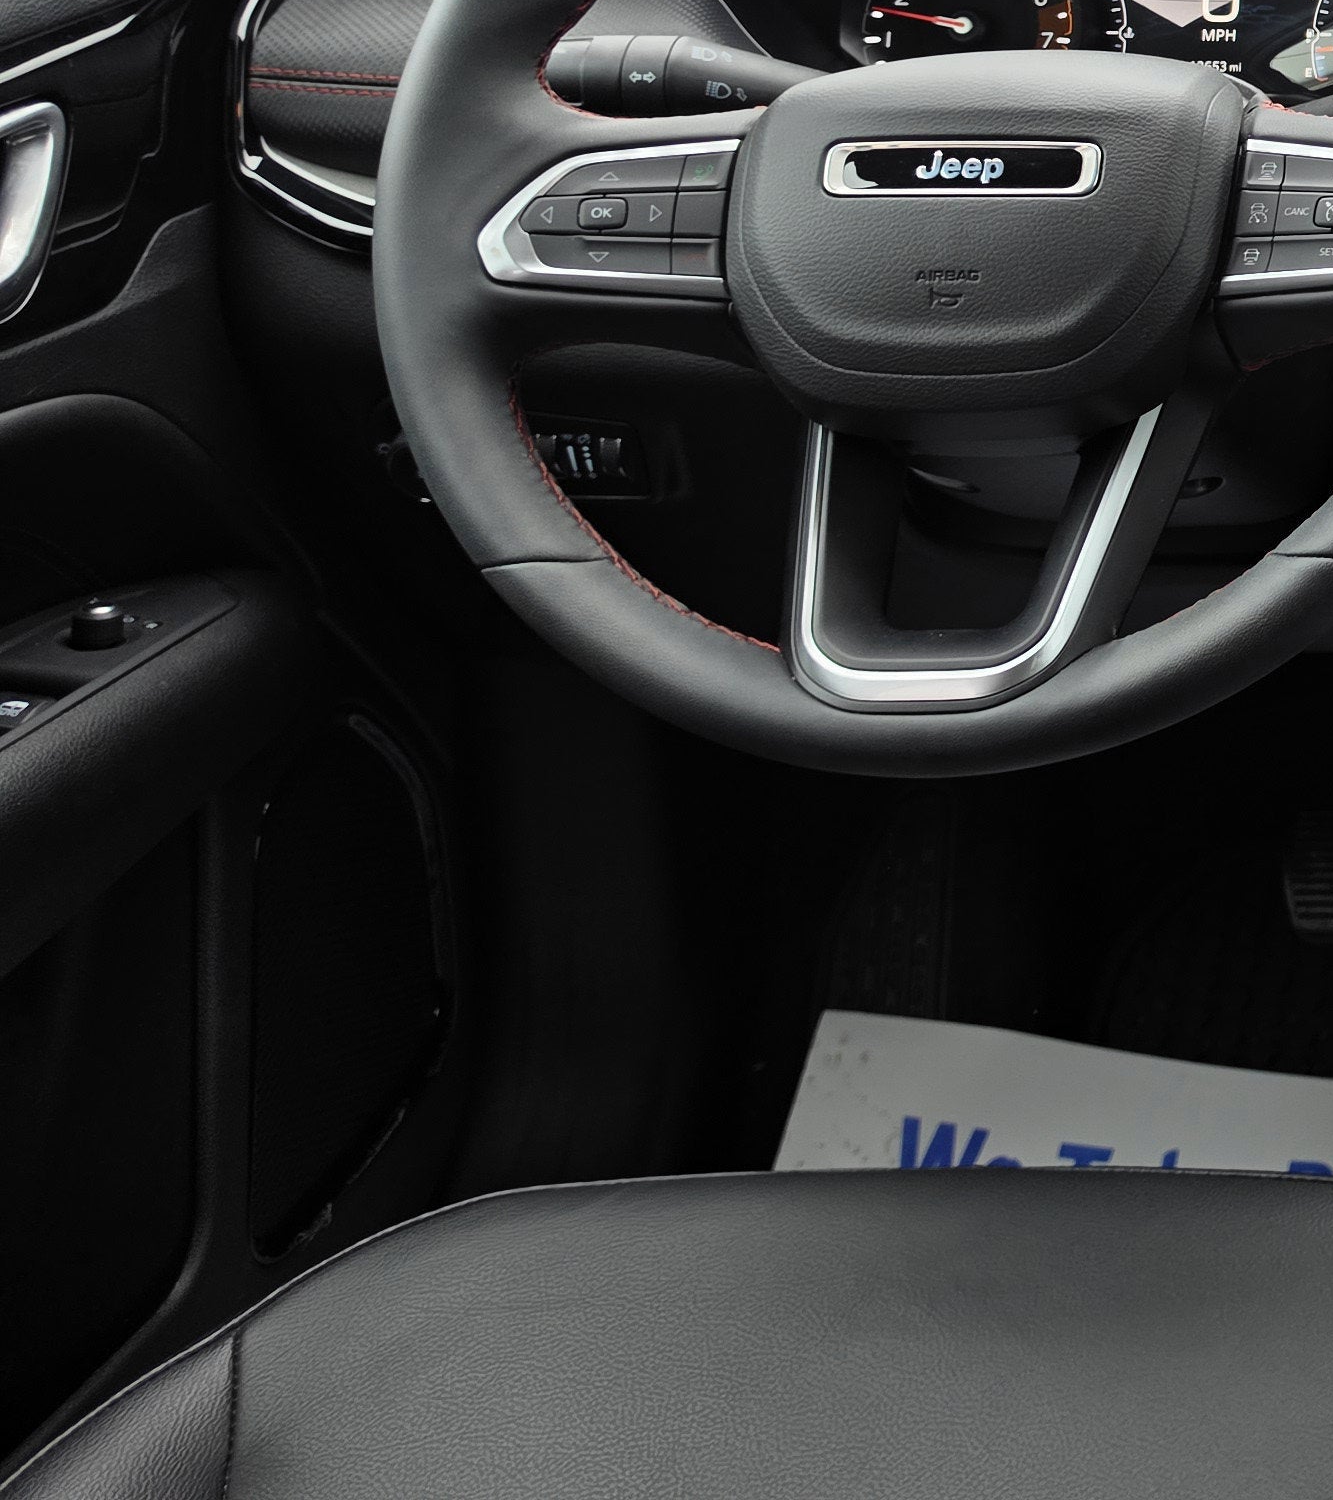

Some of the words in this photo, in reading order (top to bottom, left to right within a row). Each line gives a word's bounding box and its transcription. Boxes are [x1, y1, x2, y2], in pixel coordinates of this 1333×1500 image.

[886, 30, 892, 49] 1
[1040, 31, 1054, 49] 7
[1201, 28, 1237, 42] MPH
[1228, 62, 1242, 73] mi
[1304, 67, 1313, 78] E
[915, 150, 1004, 184] Jeep
[591, 206, 612, 219] OK
[1284, 206, 1310, 216] CANC
[915, 269, 981, 282] AIRBAG
